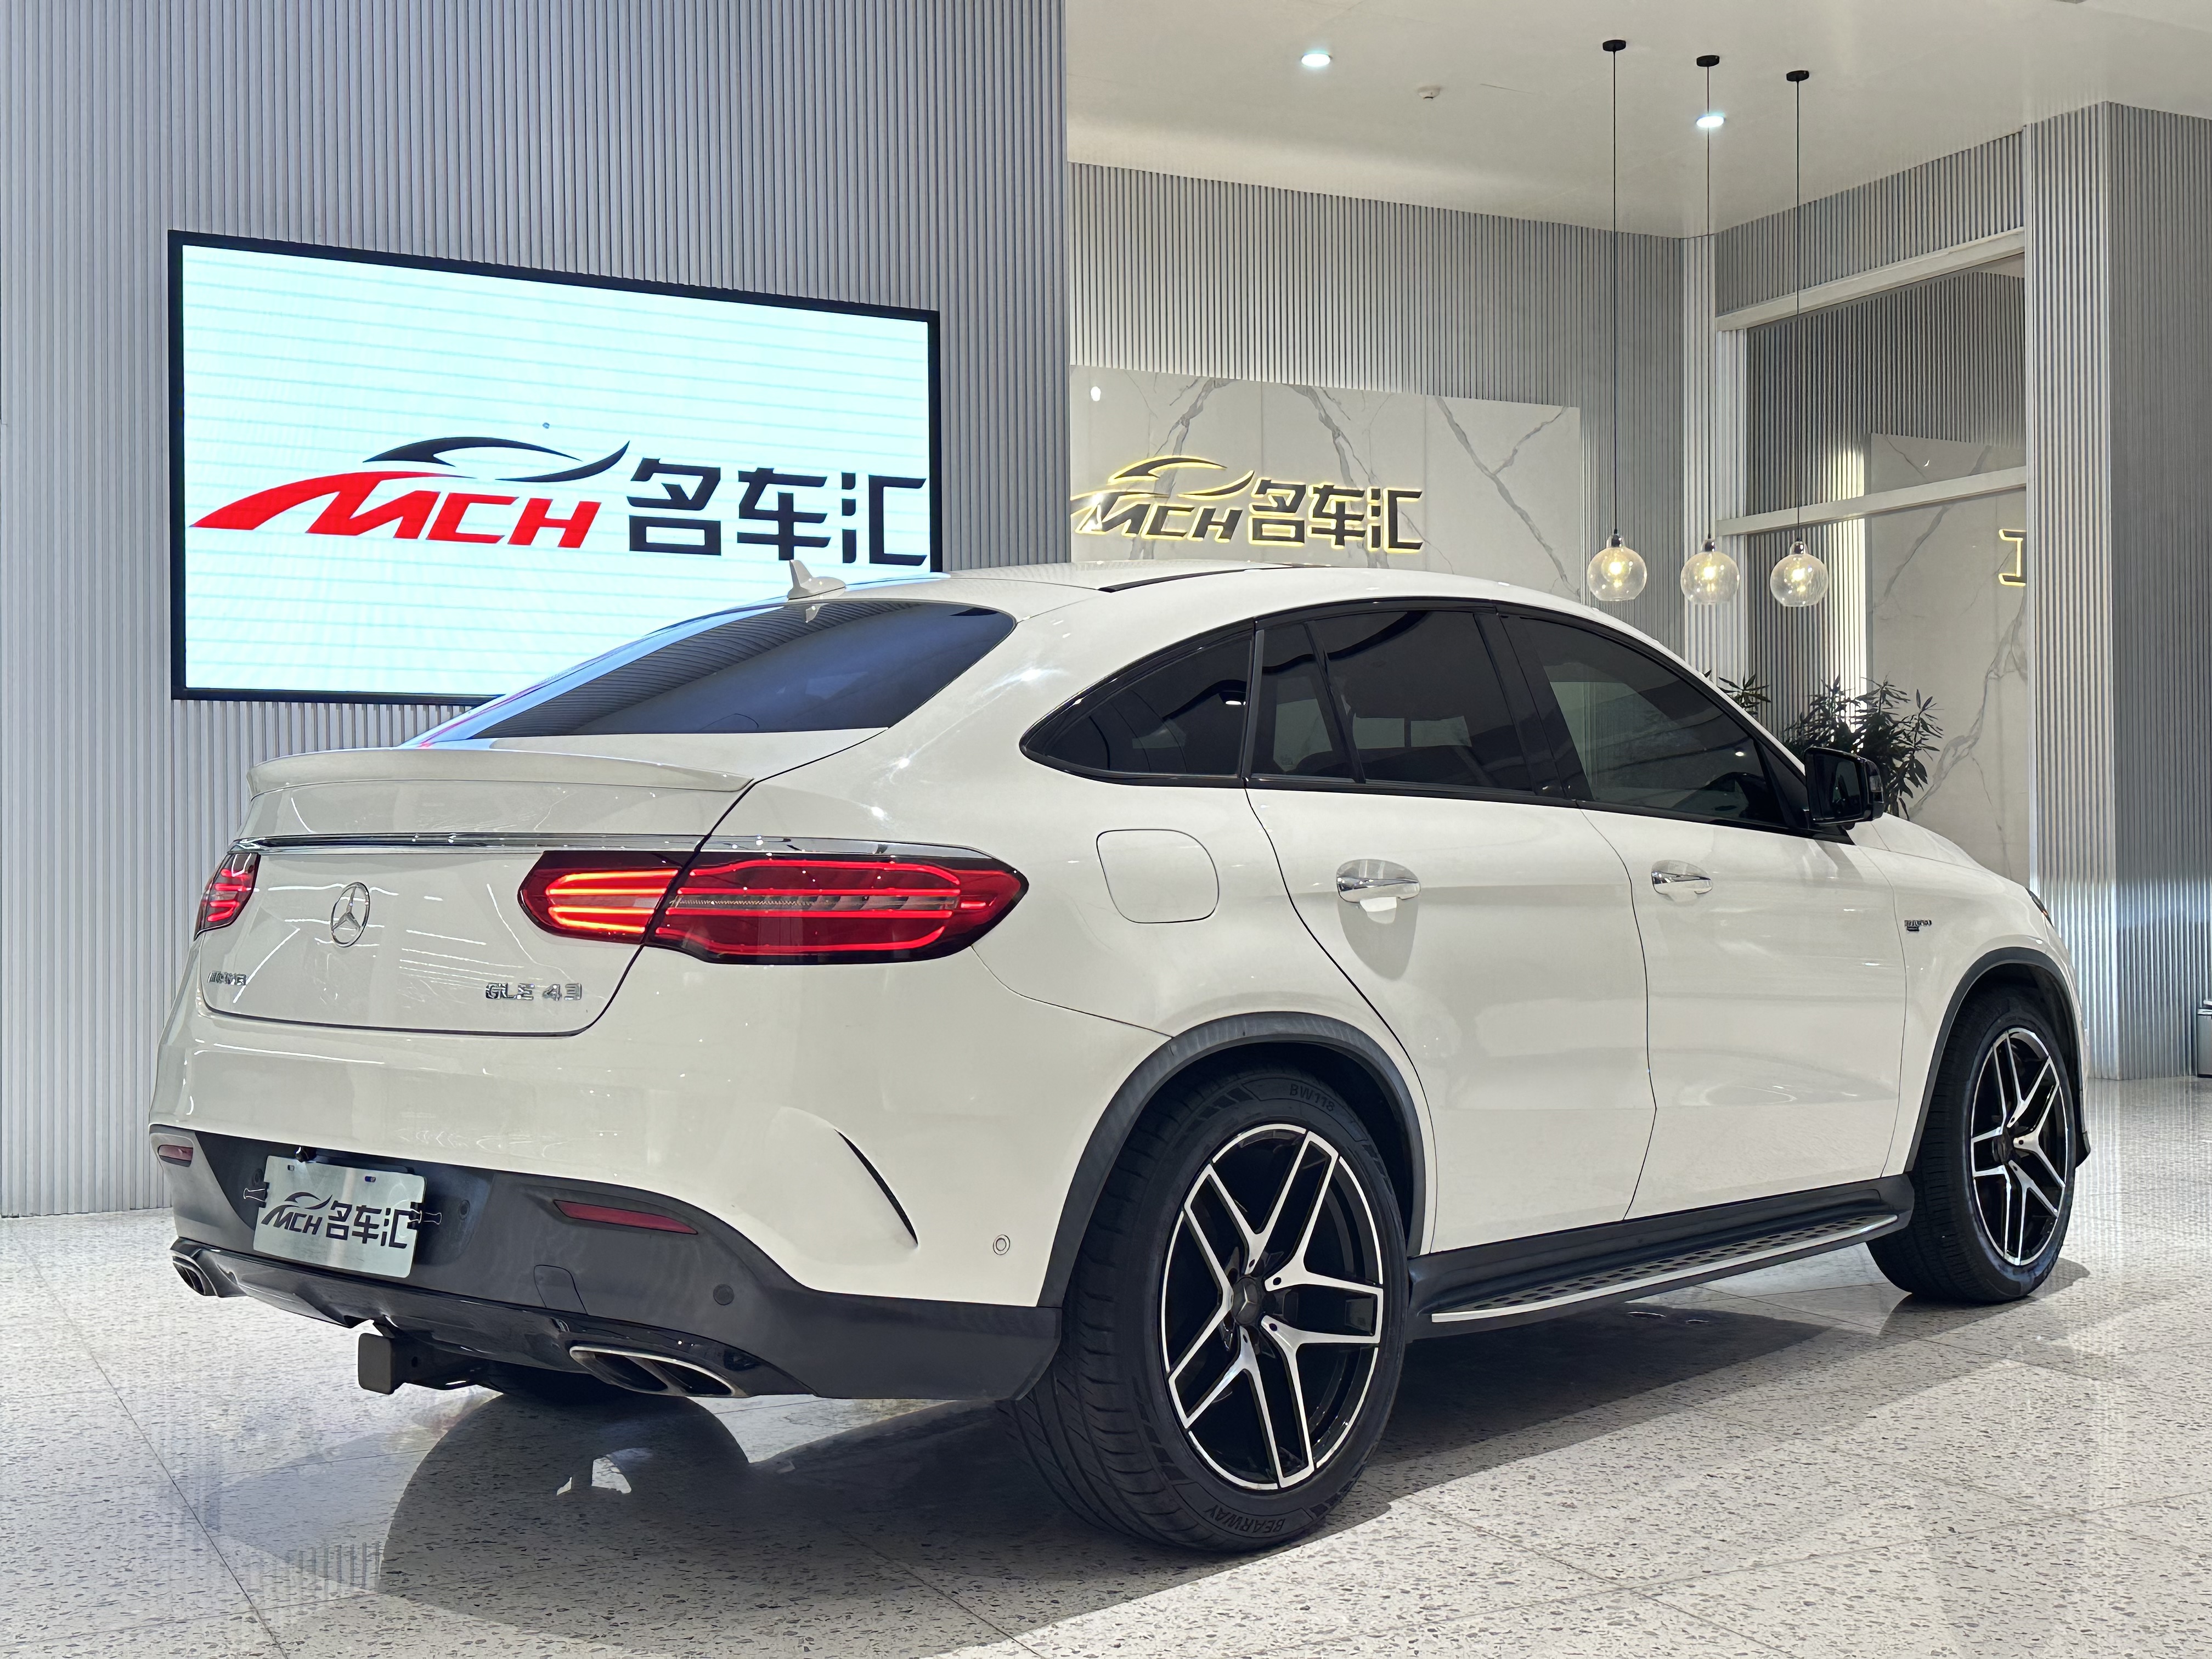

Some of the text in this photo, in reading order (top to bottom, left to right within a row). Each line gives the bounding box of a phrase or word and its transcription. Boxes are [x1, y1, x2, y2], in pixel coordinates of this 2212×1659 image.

[189, 458, 928, 566] MCH 名车汇
[1071, 478, 1424, 553] MCH 名车汇
[485, 983, 583, 1001] GLE 43
[261, 1200, 414, 1249] MCH 名车汇
[1203, 1505, 1285, 1532] BEARWAY
